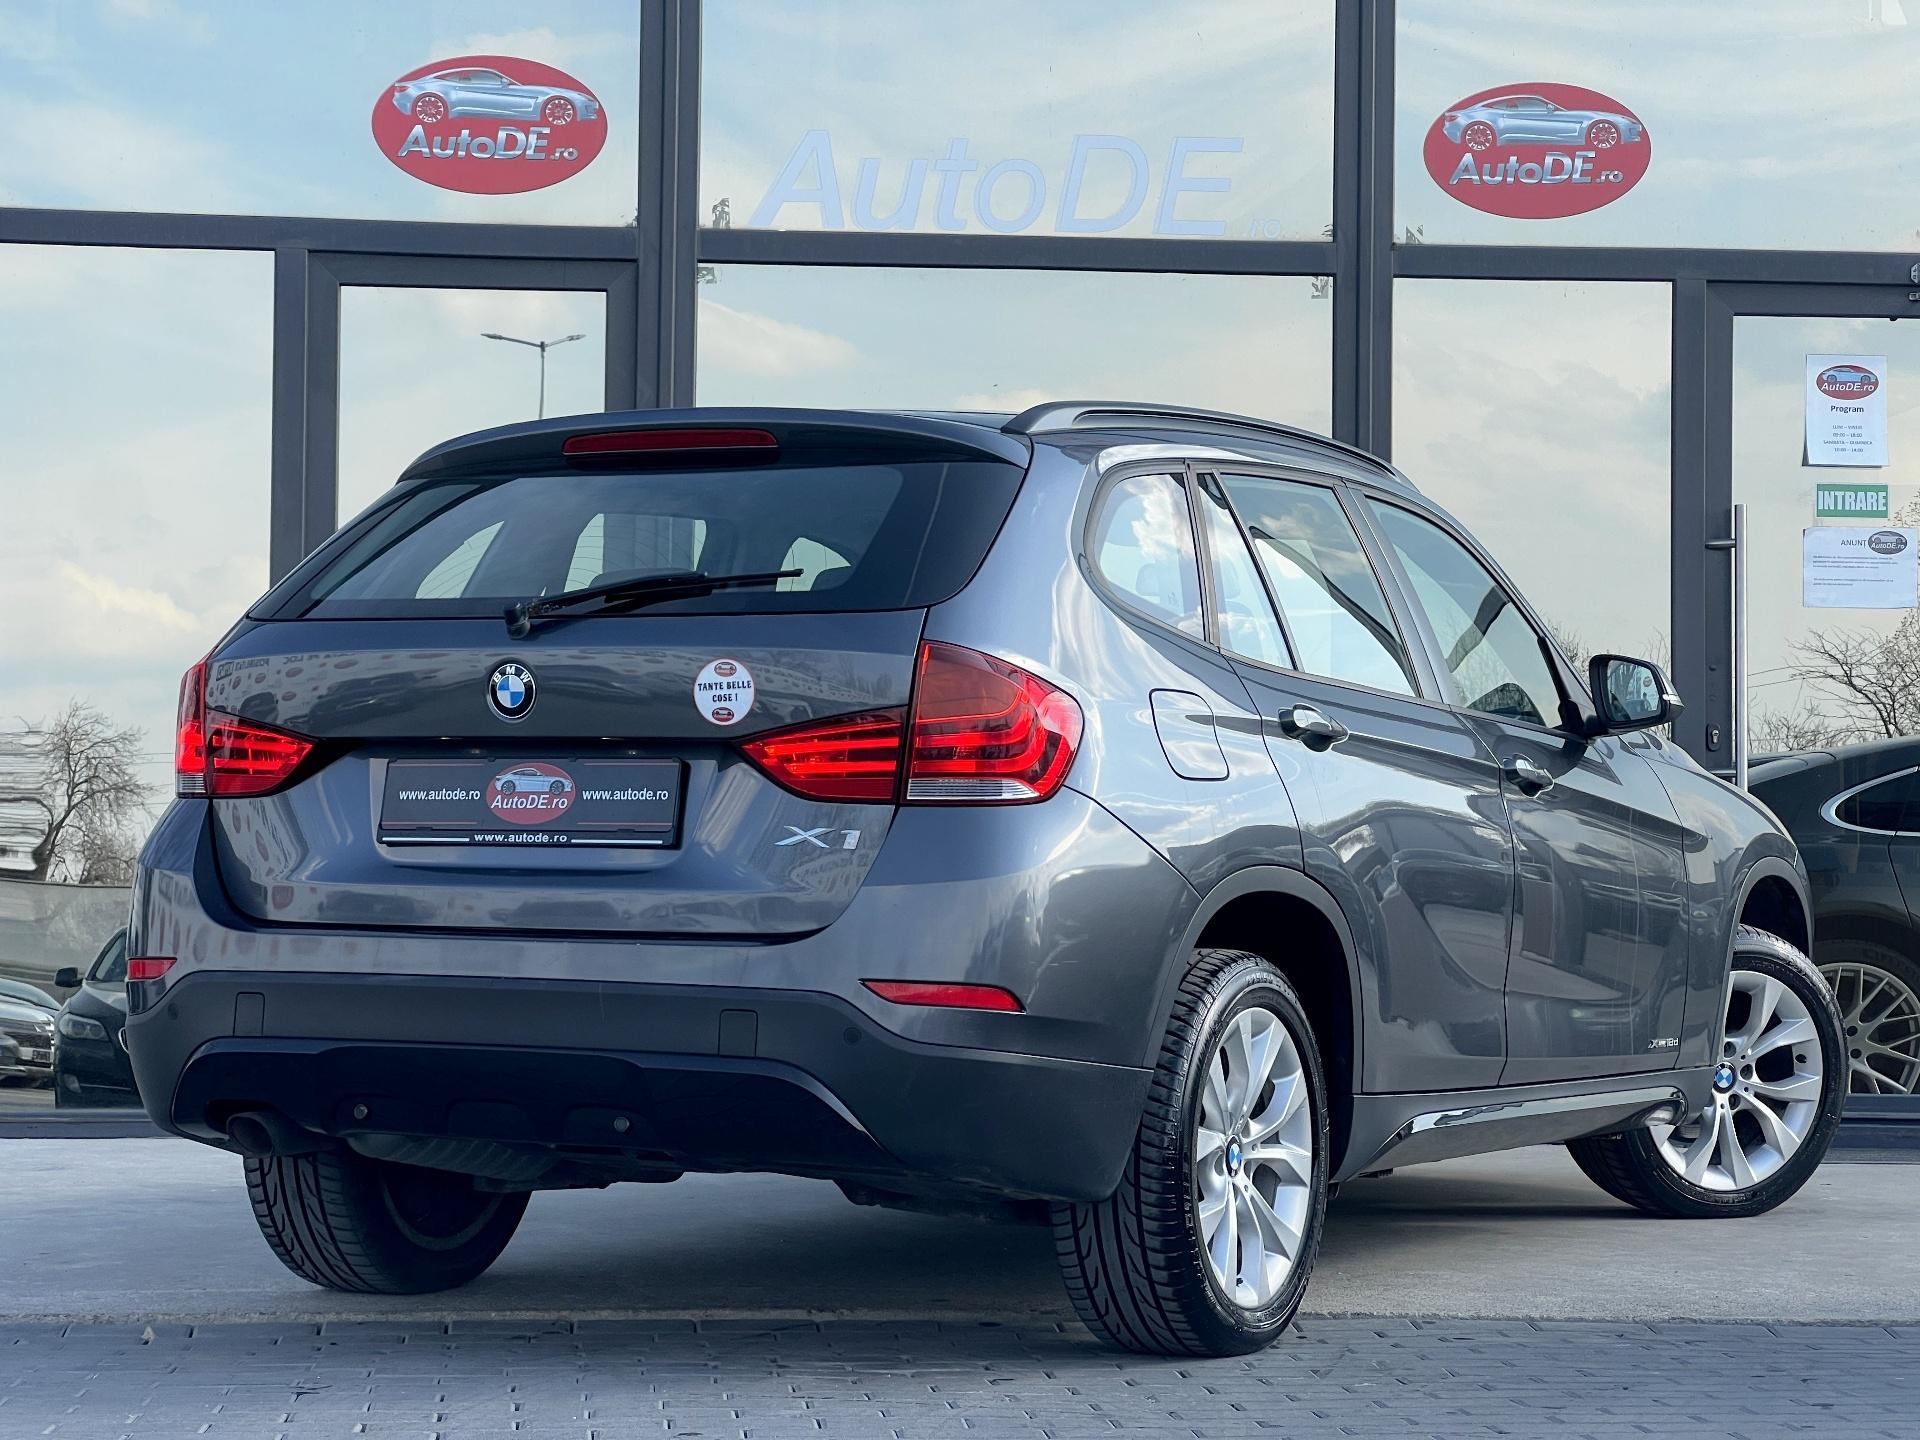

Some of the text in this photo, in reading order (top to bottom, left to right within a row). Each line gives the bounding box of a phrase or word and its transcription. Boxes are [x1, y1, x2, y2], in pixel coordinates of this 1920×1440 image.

[1820, 382, 1875, 392] AutoDE.ro
[1830, 405, 1865, 414] Program
[1817, 490, 1887, 511] INTRARE
[492, 665, 531, 683] BMW
[697, 680, 752, 691] TANTE BELLE
[712, 694, 733, 703] COSE
[399, 787, 481, 801] www.autode.ro
[582, 787, 669, 801] www.autode.ro
[491, 794, 568, 810] AutoDE.ro
[474, 832, 568, 843] www.autode.ro
[773, 825, 862, 850] X1
